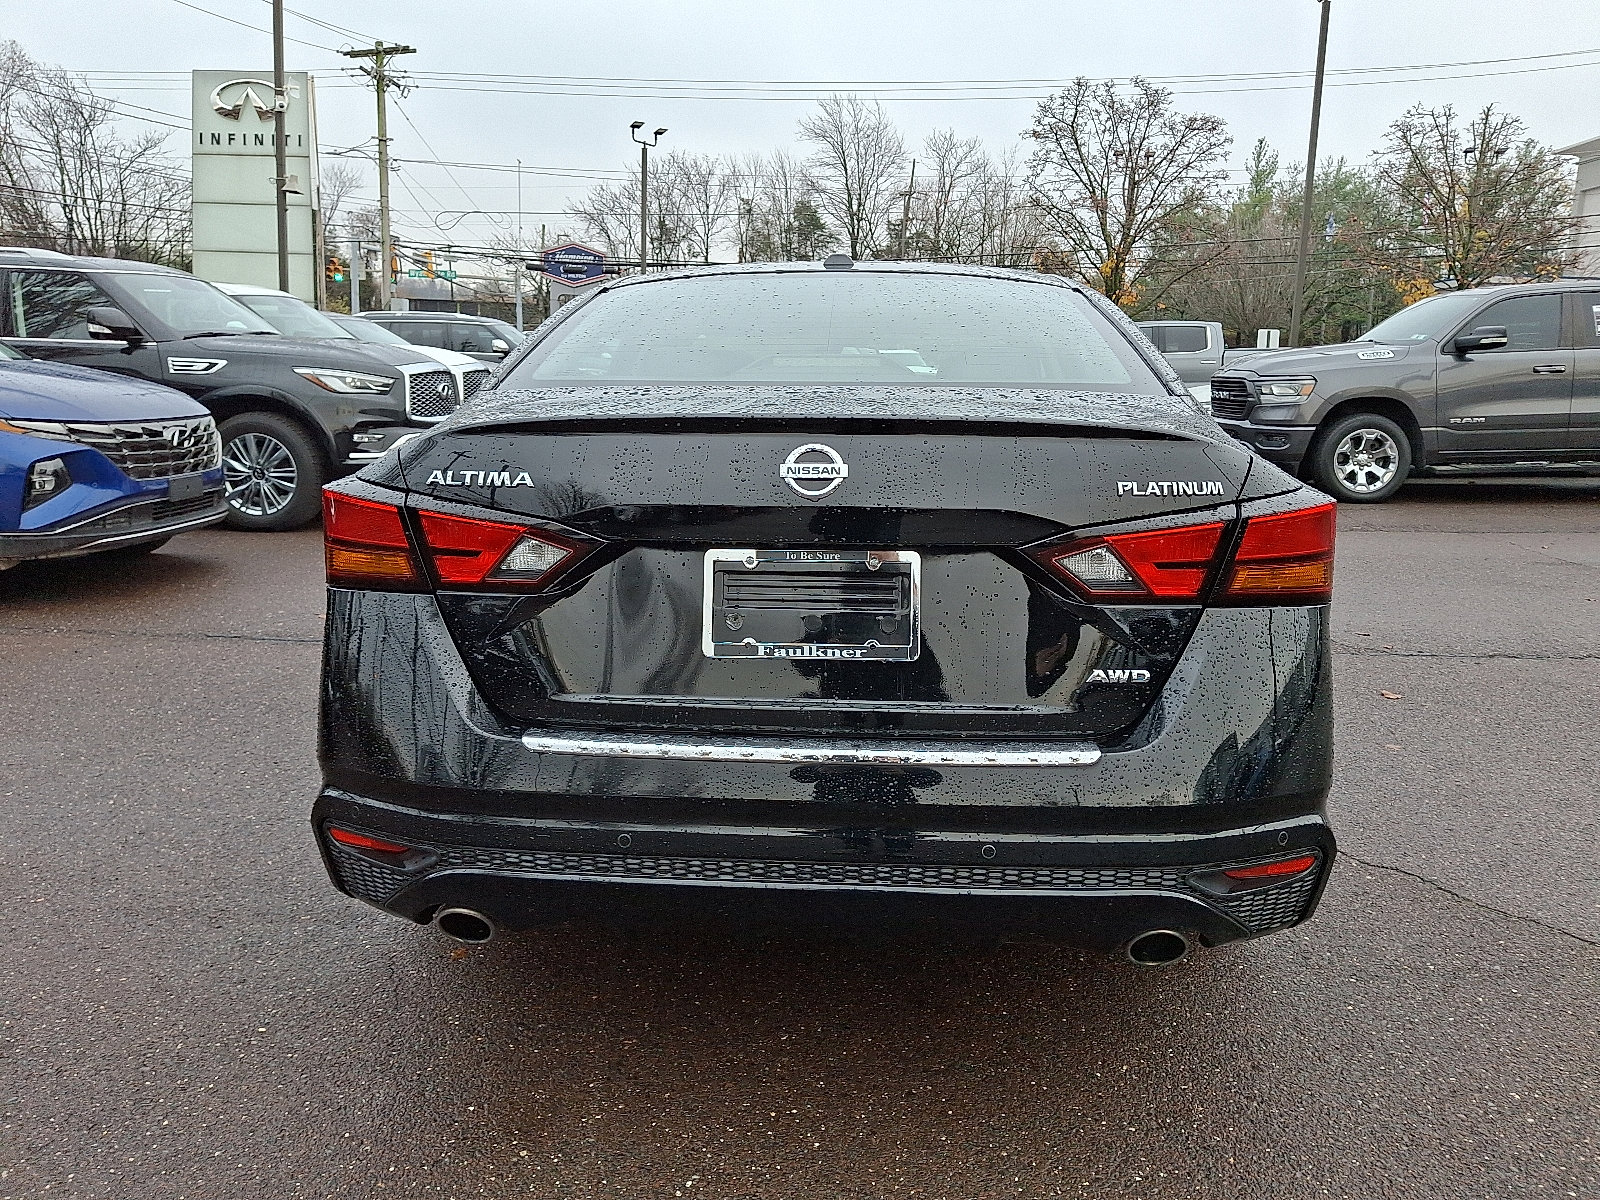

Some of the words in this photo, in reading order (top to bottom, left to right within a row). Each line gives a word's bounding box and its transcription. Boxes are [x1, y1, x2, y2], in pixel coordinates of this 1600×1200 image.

[199, 132, 302, 147] INFINITI
[786, 466, 841, 475] NISSAN
[425, 470, 535, 488] ALTIMA
[1116, 480, 1225, 497] PLATINUM
[784, 551, 797, 560] To
[800, 551, 814, 560] Be
[816, 551, 840, 561] Sure
[757, 645, 868, 658] Faulkner
[1085, 669, 1151, 684] AWD
